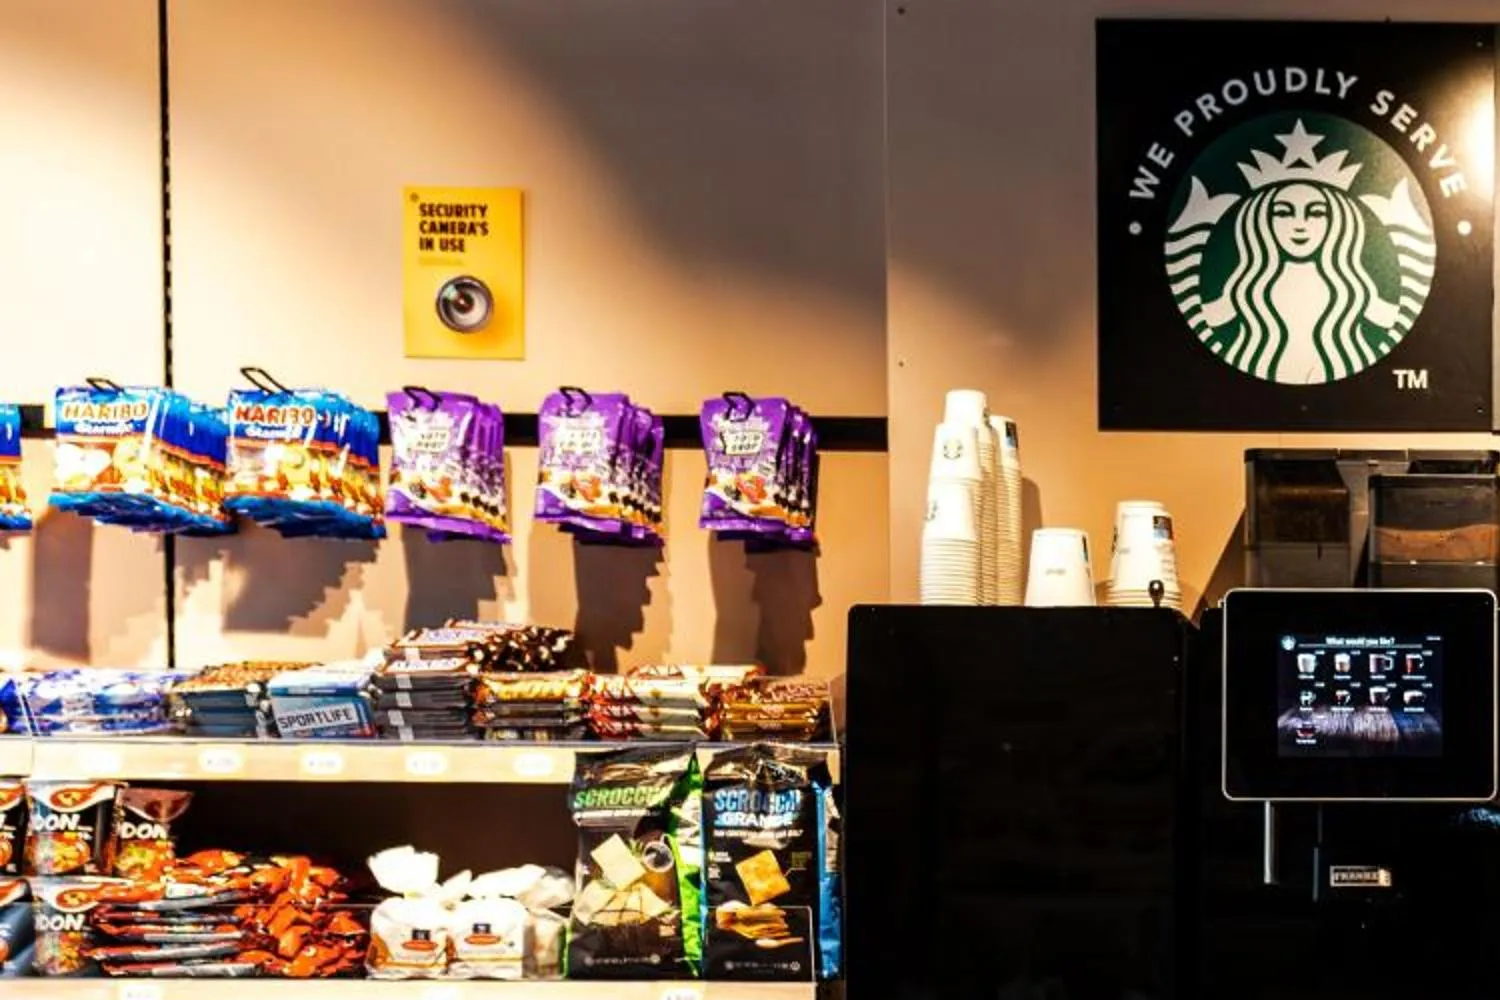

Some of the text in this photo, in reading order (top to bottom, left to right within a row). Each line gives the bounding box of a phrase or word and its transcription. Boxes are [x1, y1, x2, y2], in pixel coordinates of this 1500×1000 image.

[1129, 66, 1470, 200] WE PROUDLY SERVE
[418, 202, 488, 219] SECURITY
[418, 221, 489, 236] CAMERA'S
[419, 238, 465, 252] IN USE
[1392, 368, 1428, 389] TM
[62, 402, 149, 422] HARIBO
[277, 707, 354, 730] SPORTLIFE
